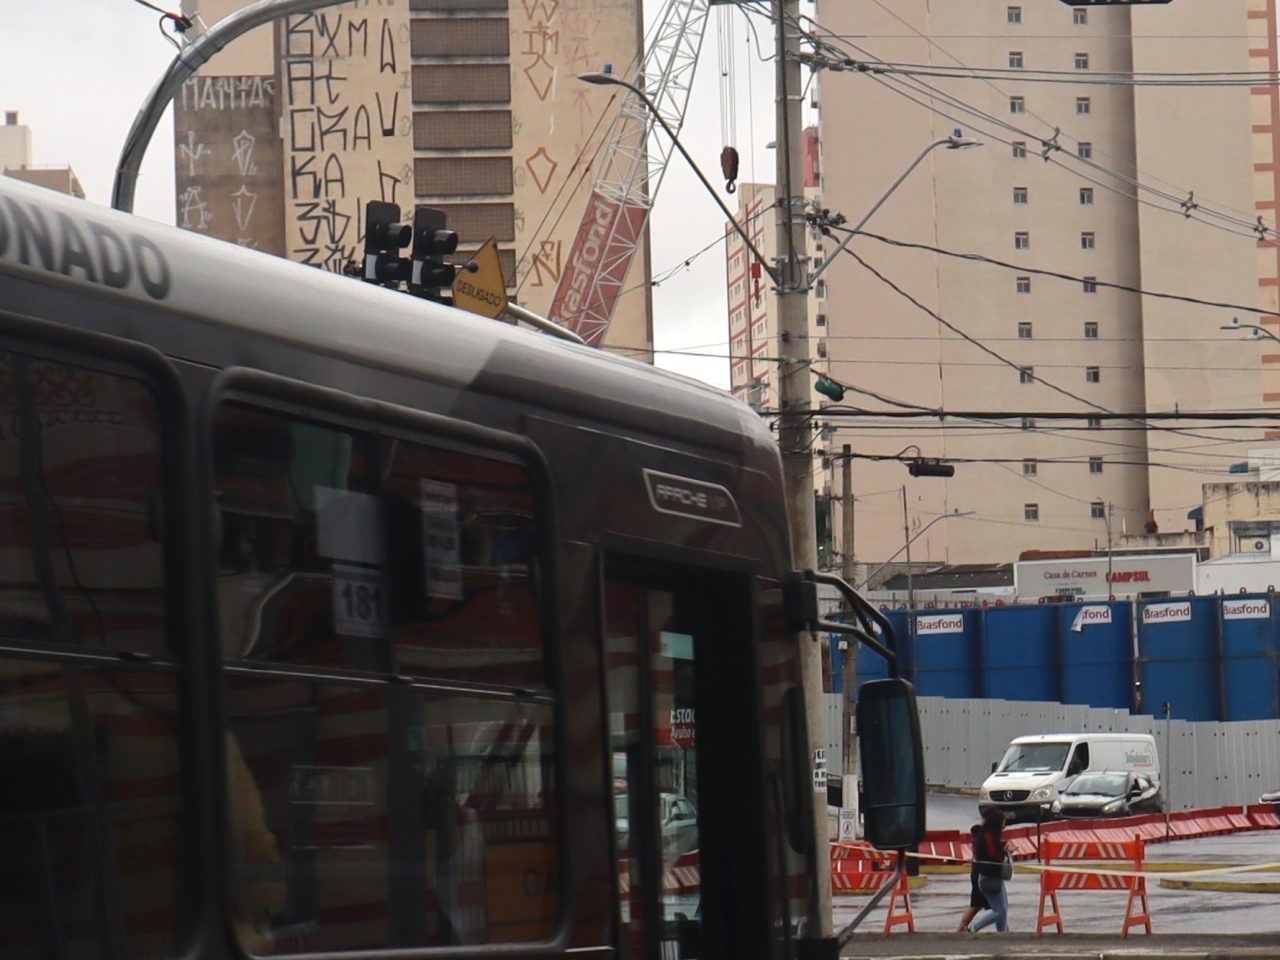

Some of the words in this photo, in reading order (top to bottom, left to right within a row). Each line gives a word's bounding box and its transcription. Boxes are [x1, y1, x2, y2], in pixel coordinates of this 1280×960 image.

[0, 196, 171, 301] NADO
[456, 279, 501, 308] DESLIGADO
[1043, 571, 1061, 580] Casa
[1062, 570, 1071, 579] de
[1071, 570, 1098, 578] Carnes
[1105, 570, 1150, 583] CAMPSUL
[1083, 607, 1110, 620] fond
[1144, 606, 1191, 620] Brasfond
[1223, 603, 1268, 615] Brasfond
[917, 618, 963, 631] Brasfond
